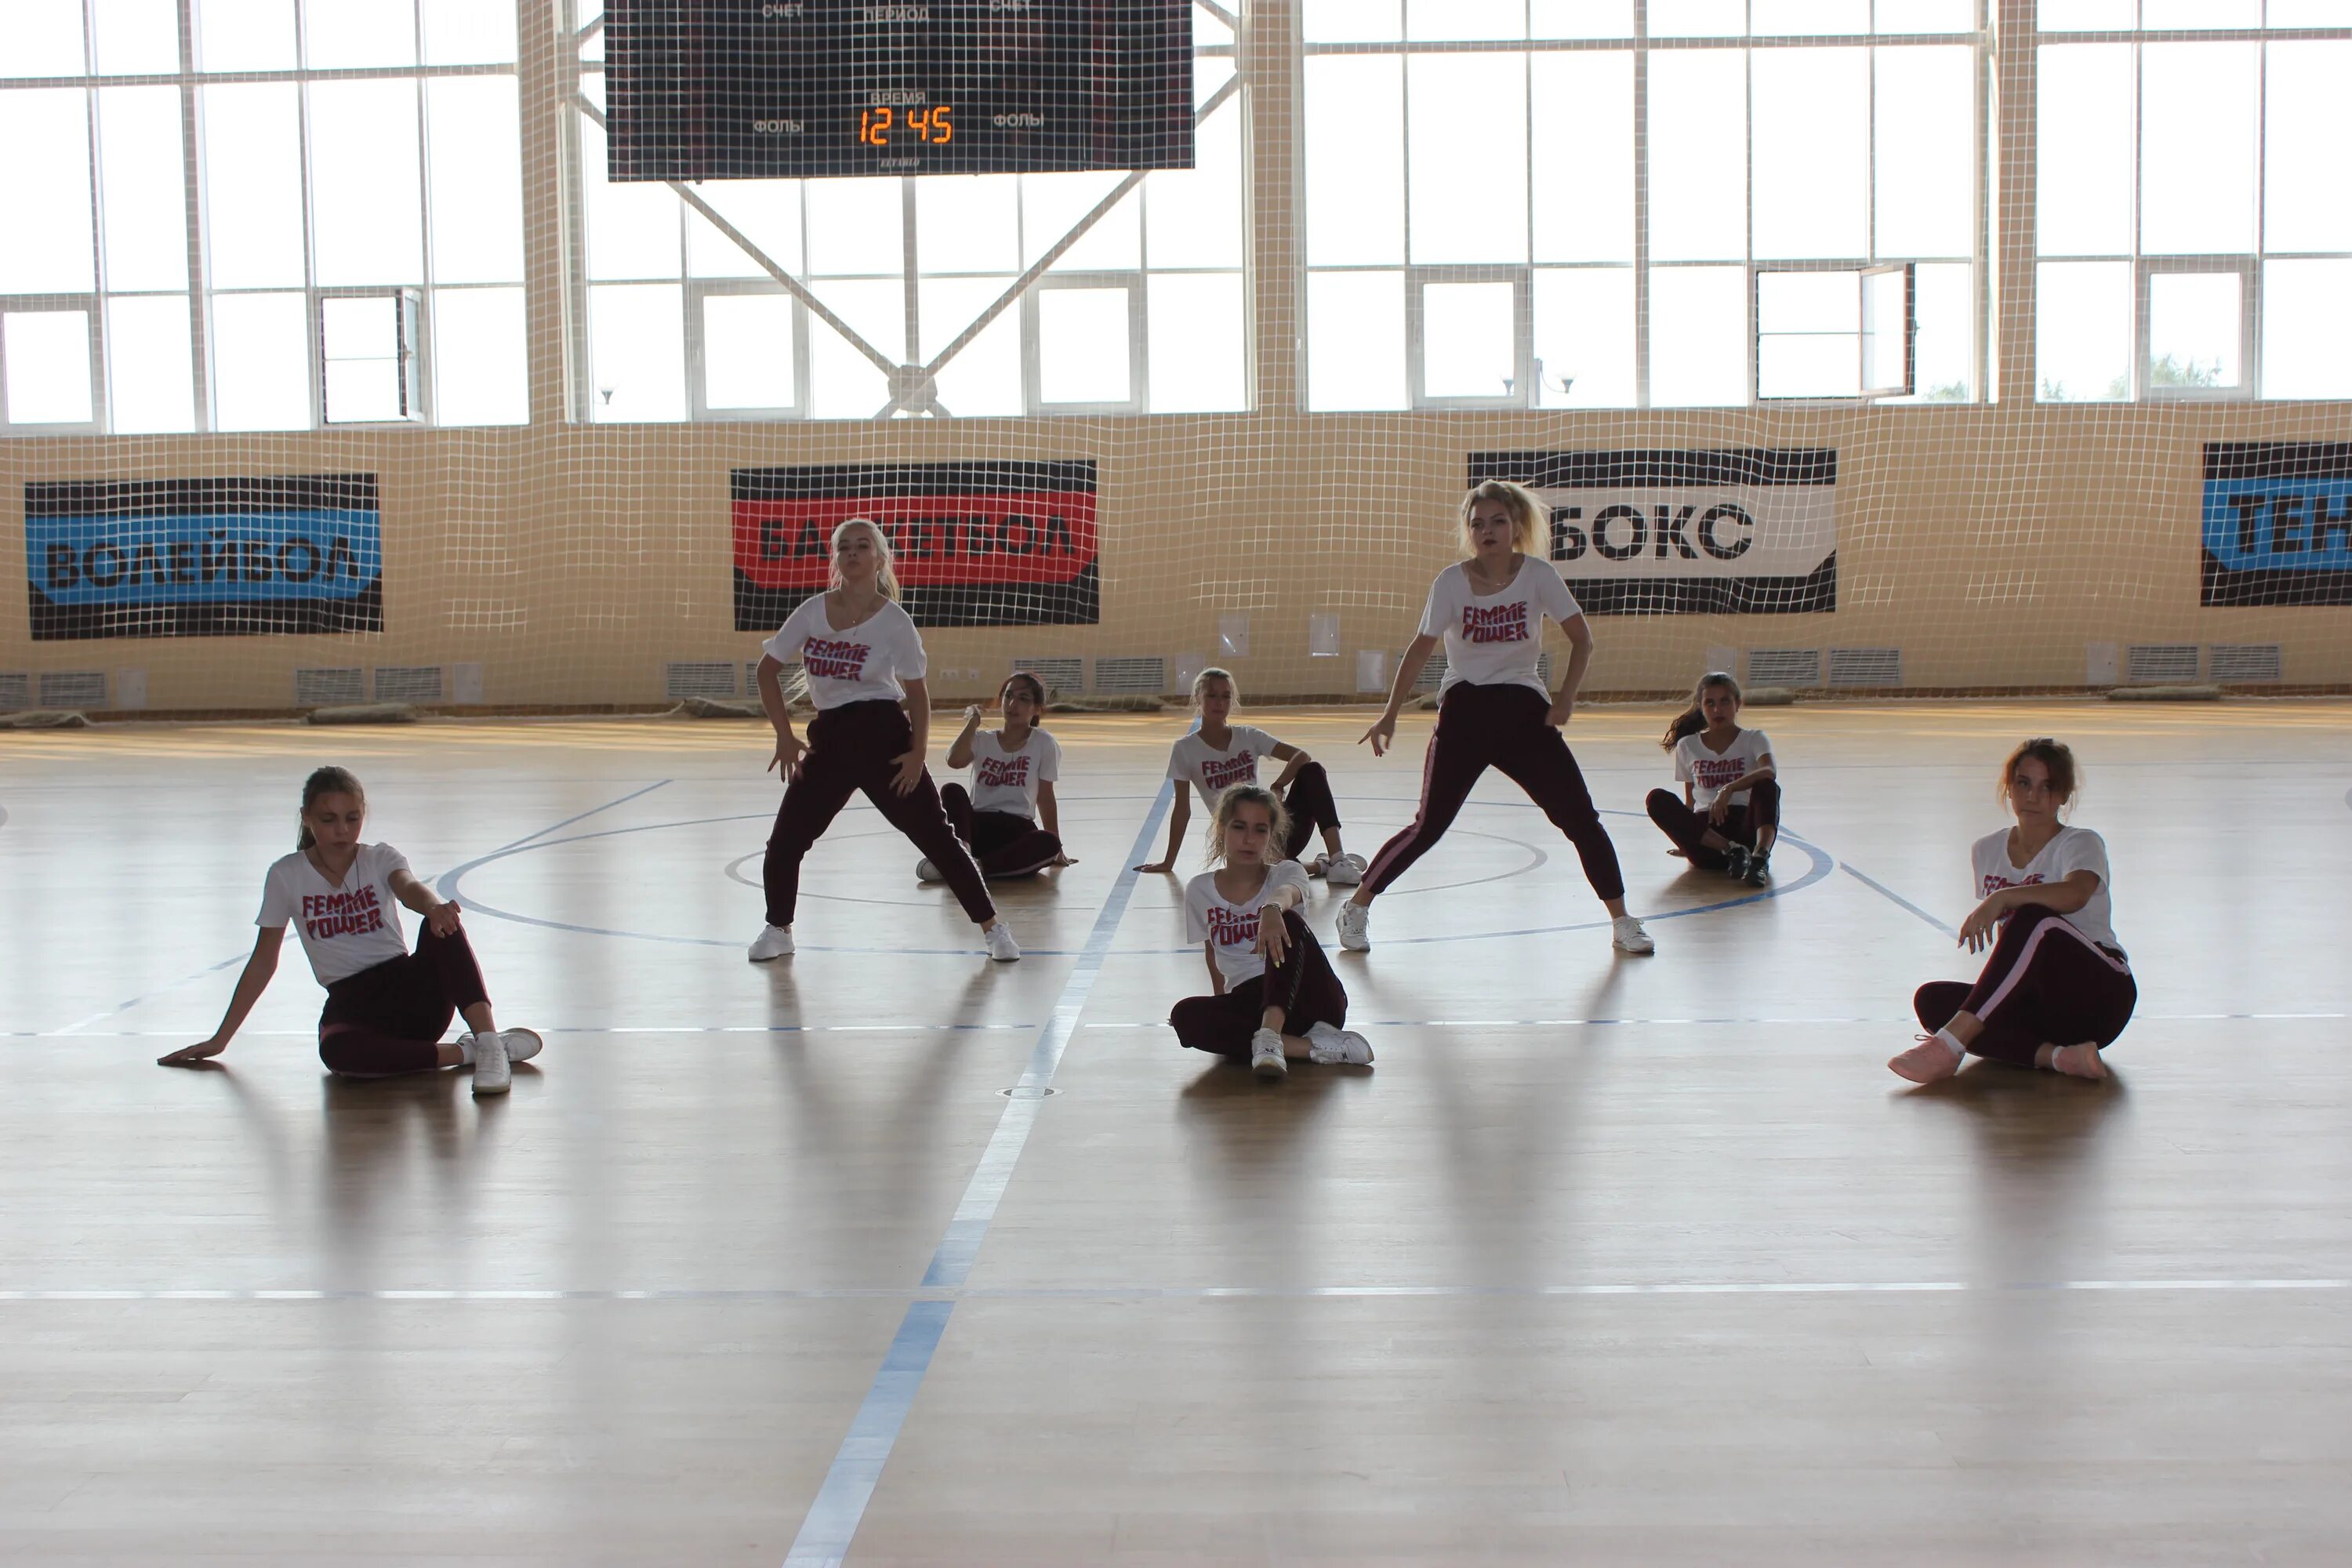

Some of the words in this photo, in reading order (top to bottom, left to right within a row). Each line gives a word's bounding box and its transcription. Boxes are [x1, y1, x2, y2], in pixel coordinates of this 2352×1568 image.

[762, 4, 804, 18] СЧЕТ
[863, 5, 929, 23] ПЕРИОД
[870, 92, 926, 106] ВРЕМЯ
[753, 120, 805, 133] ФОЛЫ
[861, 107, 891, 144] 12
[908, 107, 951, 143] 45
[993, 113, 1045, 127] ФОЛЫ
[760, 513, 1075, 561] БАКЕТБОЛ
[1550, 503, 1754, 561] БОКС
[45, 530, 359, 588] ВОЛЕЙБОЛ
[1462, 601, 1528, 625] FEMME
[1462, 621, 1530, 643] POWER
[804, 636, 872, 663] FEMME
[982, 756, 1030, 774] FEMME
[1202, 750, 1254, 777] FEMME
[1693, 757, 1745, 774] FEMME
[977, 770, 1027, 787] POWER
[1205, 764, 1255, 790] POWER
[303, 884, 380, 918] FEMME
[306, 907, 383, 940] POWER
[1210, 921, 1261, 947] POW
